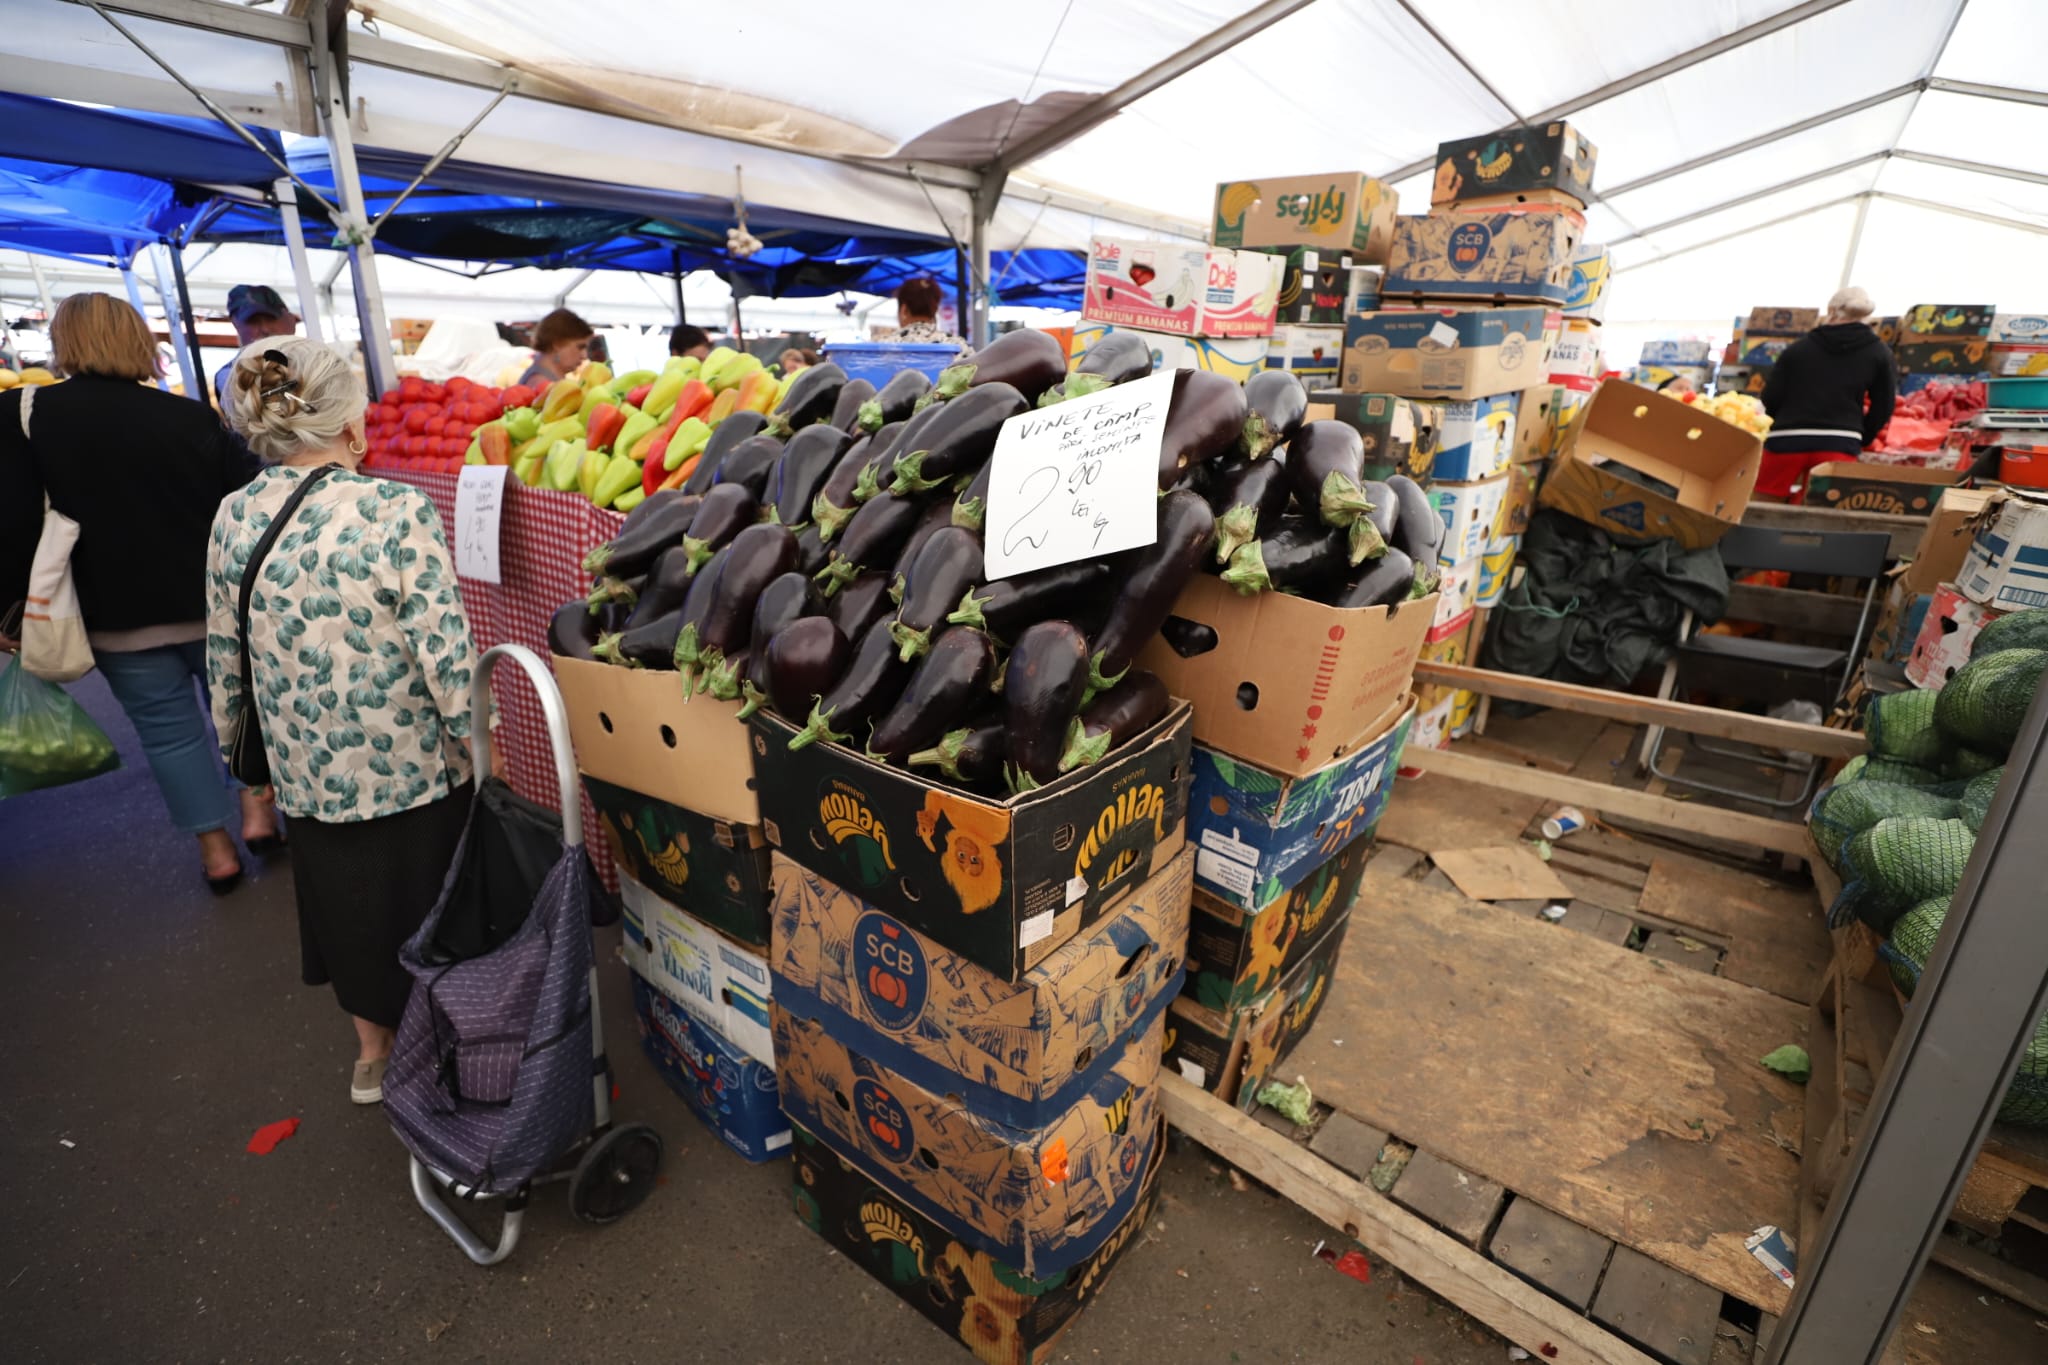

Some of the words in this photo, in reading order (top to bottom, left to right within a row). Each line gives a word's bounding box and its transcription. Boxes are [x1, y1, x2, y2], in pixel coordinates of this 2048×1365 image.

[1276, 184, 1346, 225] fyffes
[1455, 233, 1484, 245] SCB
[1208, 264, 1237, 290] Dole
[1088, 308, 1134, 323] PREMIUM
[1136, 314, 1189, 332] BANANAS
[1062, 427, 1082, 440] DE
[1003, 466, 1060, 557] 2
[1068, 460, 1102, 495] 90
[820, 793, 896, 871] yellow
[866, 933, 914, 975] SCB
[863, 1093, 903, 1129] SCB
[861, 1202, 928, 1276] yellow
